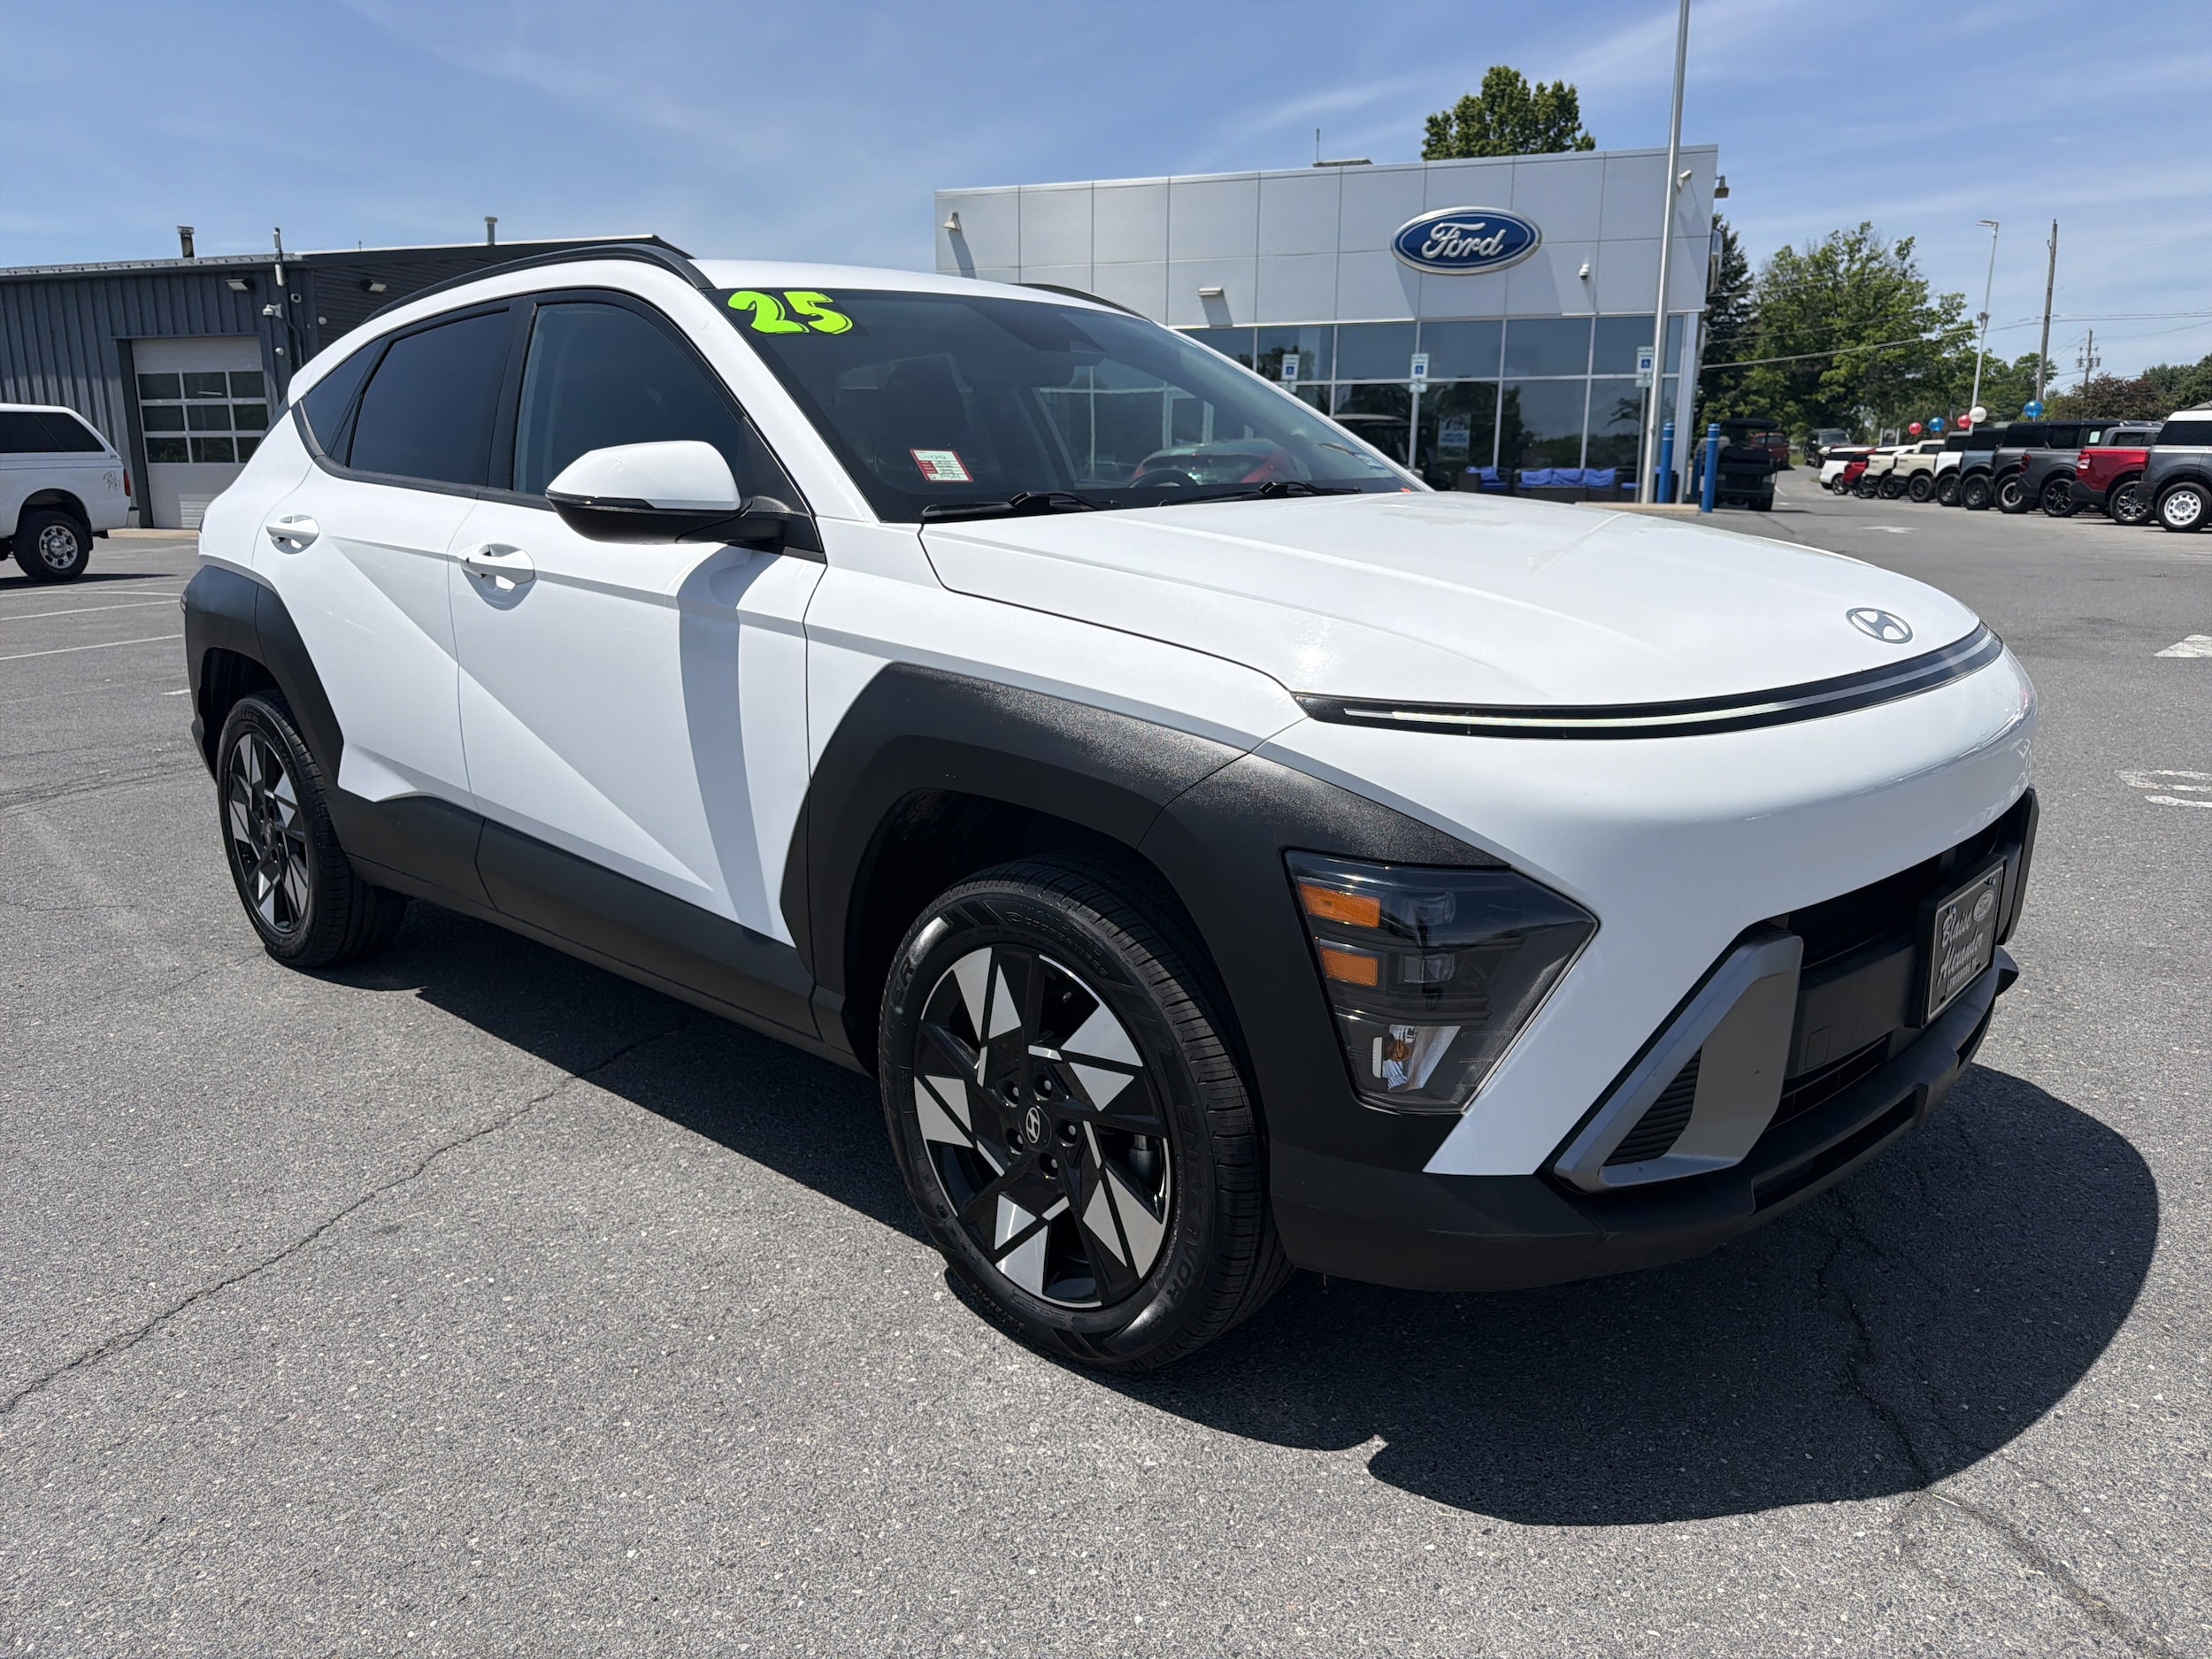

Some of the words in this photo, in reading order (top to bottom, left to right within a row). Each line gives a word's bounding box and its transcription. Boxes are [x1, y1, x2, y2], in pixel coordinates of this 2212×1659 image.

[1421, 222, 1506, 258] Ford
[727, 290, 854, 334] 25
[1941, 910, 1973, 949] Blaise
[1937, 926, 1984, 987] Alexander
